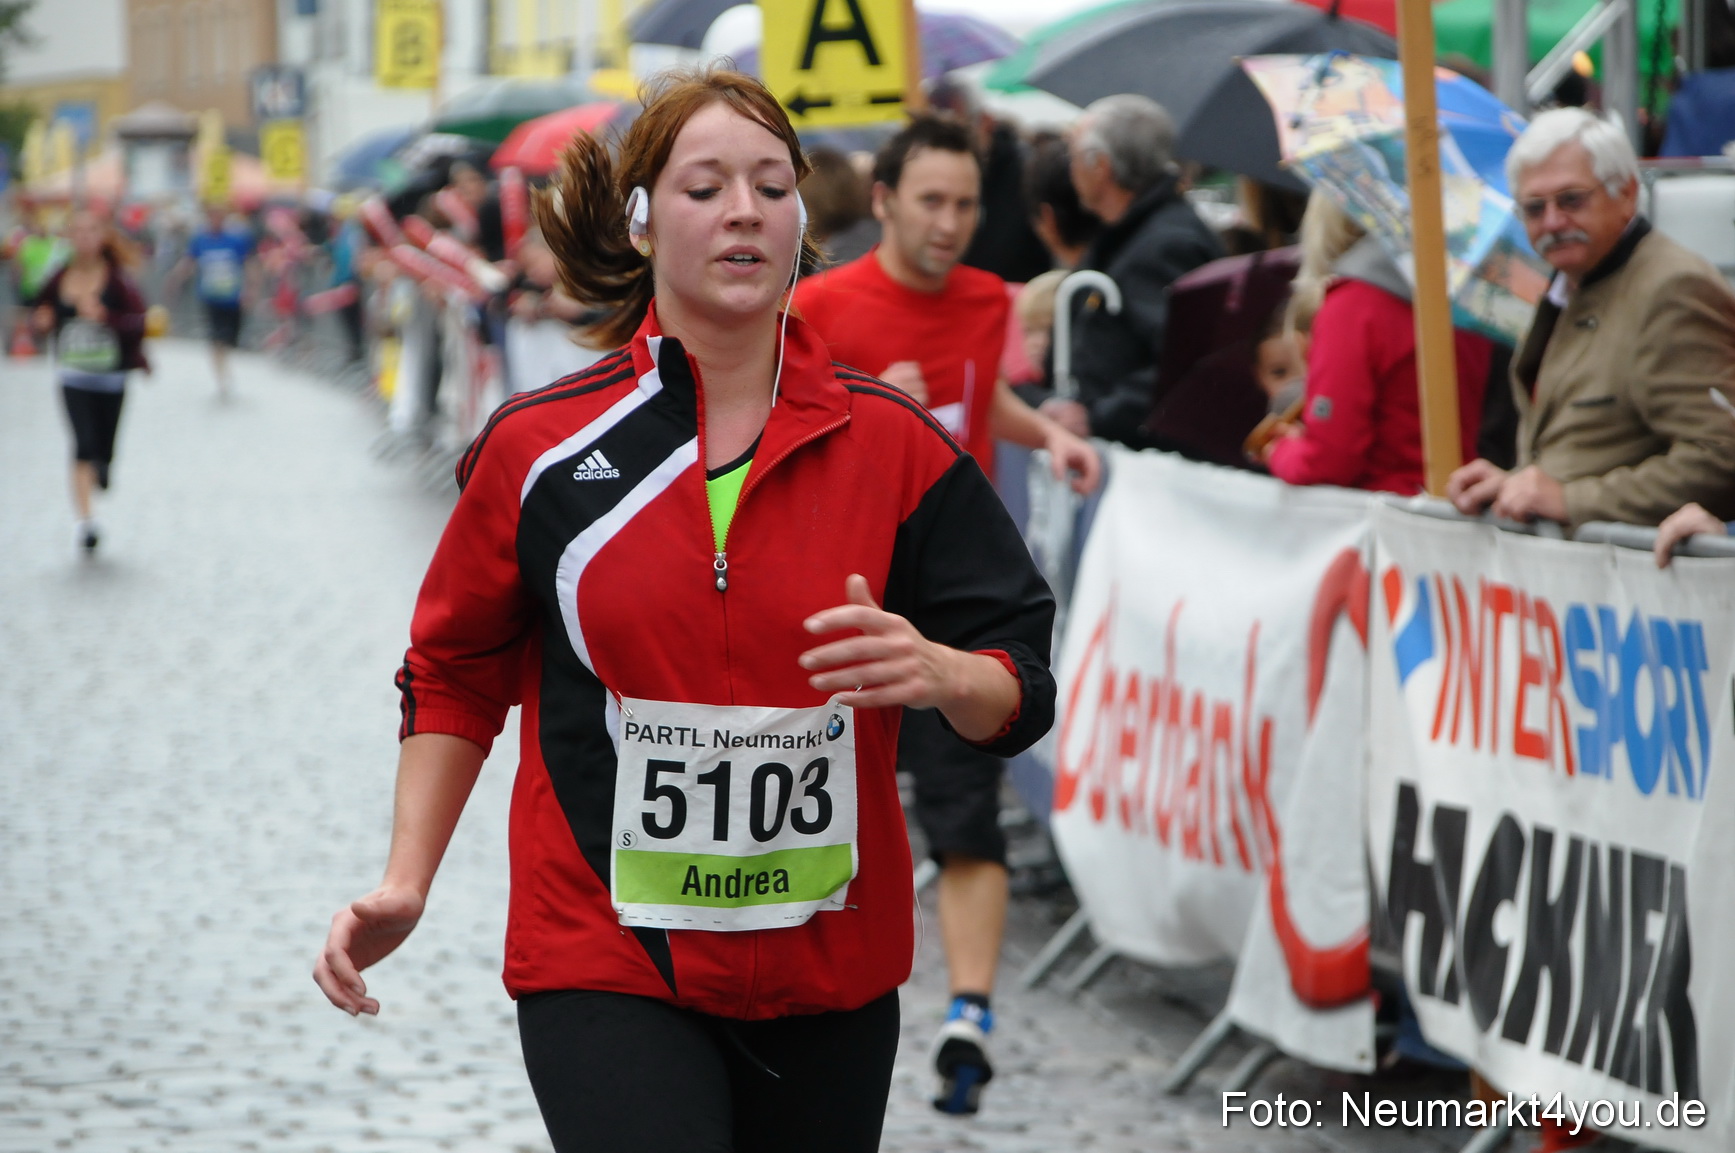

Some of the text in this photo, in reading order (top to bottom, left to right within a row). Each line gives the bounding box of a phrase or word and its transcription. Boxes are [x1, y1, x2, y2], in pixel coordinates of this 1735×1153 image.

[798, 0, 883, 69] A
[573, 468, 620, 480] adidas
[1430, 571, 1710, 800] INTERSPORT
[625, 721, 823, 750] PARTL Neumarkt
[641, 756, 833, 843] 5103
[622, 832, 632, 847] S
[680, 865, 790, 899] Andrea
